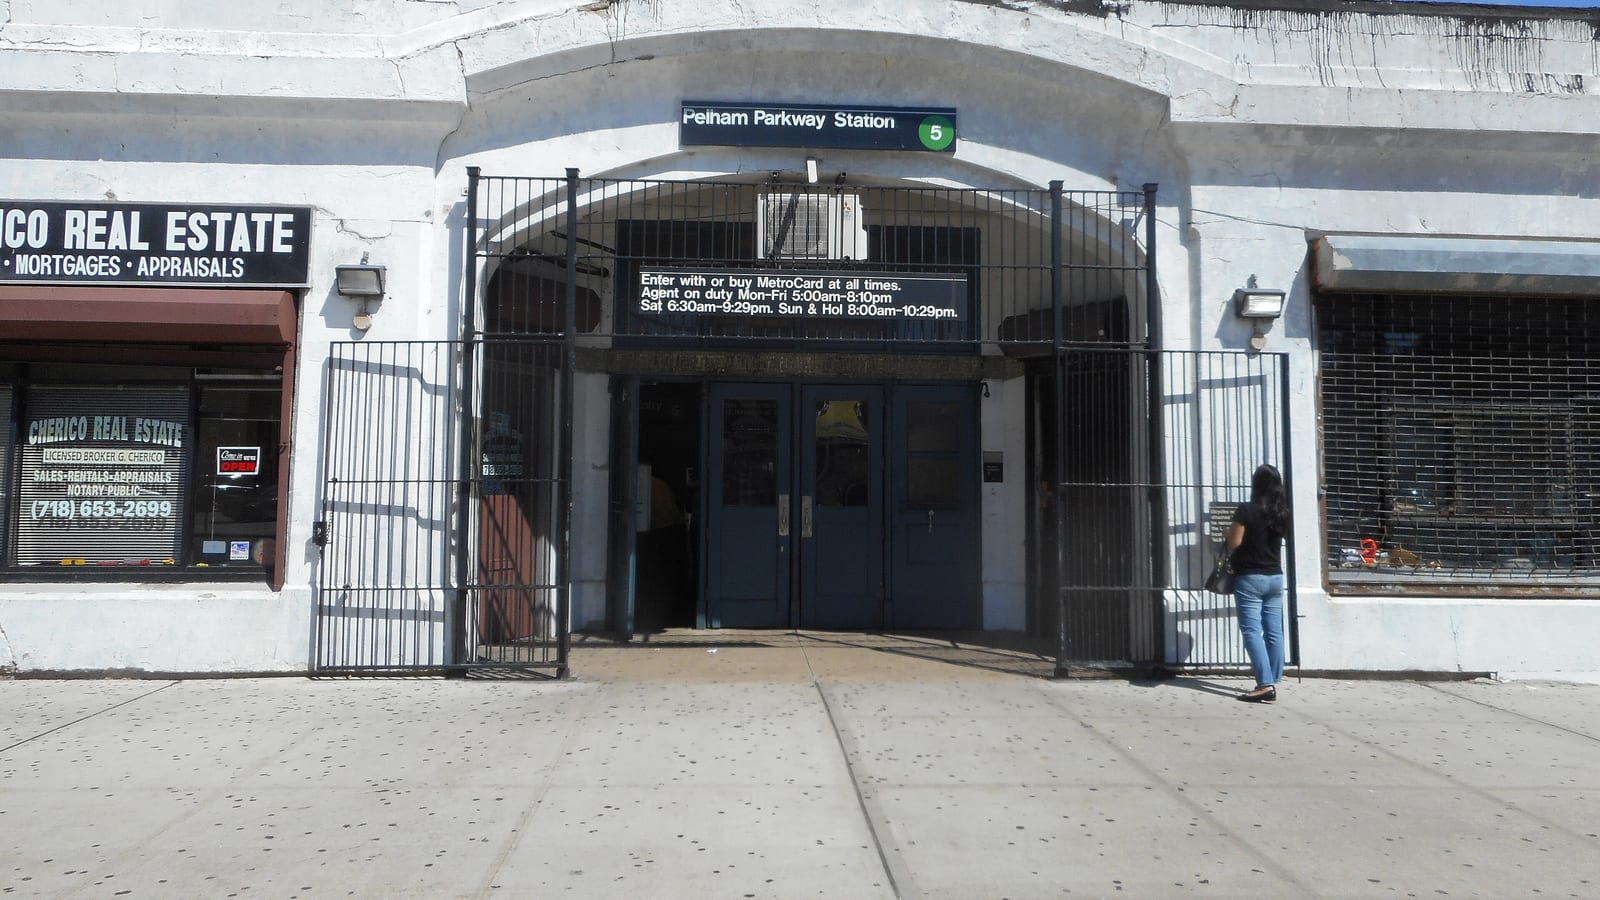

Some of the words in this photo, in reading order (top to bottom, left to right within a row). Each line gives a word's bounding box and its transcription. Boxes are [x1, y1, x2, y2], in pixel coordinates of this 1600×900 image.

[683, 108, 748, 126] Pelham
[754, 111, 825, 130] Parkway
[834, 111, 895, 129] Station
[929, 125, 943, 141] 5
[63, 209, 150, 251] REAL
[166, 211, 294, 253] ESTATE
[15, 254, 121, 276] MORTGAGES
[137, 257, 244, 278] APPRAISALS
[641, 274, 675, 287] Enter
[680, 276, 706, 288] with
[711, 278, 725, 288] or
[729, 277, 752, 292] buy
[756, 277, 823, 290] MetroCard
[828, 280, 841, 290] at
[845, 279, 859, 290] all
[864, 279, 902, 291] times.
[641, 288, 680, 302] Agent
[685, 290, 701, 300] on
[705, 288, 733, 303] duty
[738, 289, 788, 301] Mon-Fri
[791, 290, 893, 305] 5:00am-8:10pm
[641, 301, 663, 312] Sat
[667, 302, 774, 315] 6:30am-9:29pm.
[778, 304, 803, 315] Sun
[807, 305, 817, 315] &
[822, 305, 843, 316] Hol
[847, 305, 958, 319] 8:00am-10:29pm.
[29, 416, 87, 445] CHERICO
[93, 416, 128, 440] REAL
[134, 418, 182, 448] ESTATE
[45, 450, 82, 462] LICENSED
[84, 452, 116, 462] BROKER
[128, 452, 163, 462] CHERICO
[221, 462, 256, 471] OPEN
[67, 484, 104, 497] NOTARY
[107, 485, 140, 497] PUBLIC
[31, 500, 75, 520] (718)
[80, 500, 172, 517] 653-2699
